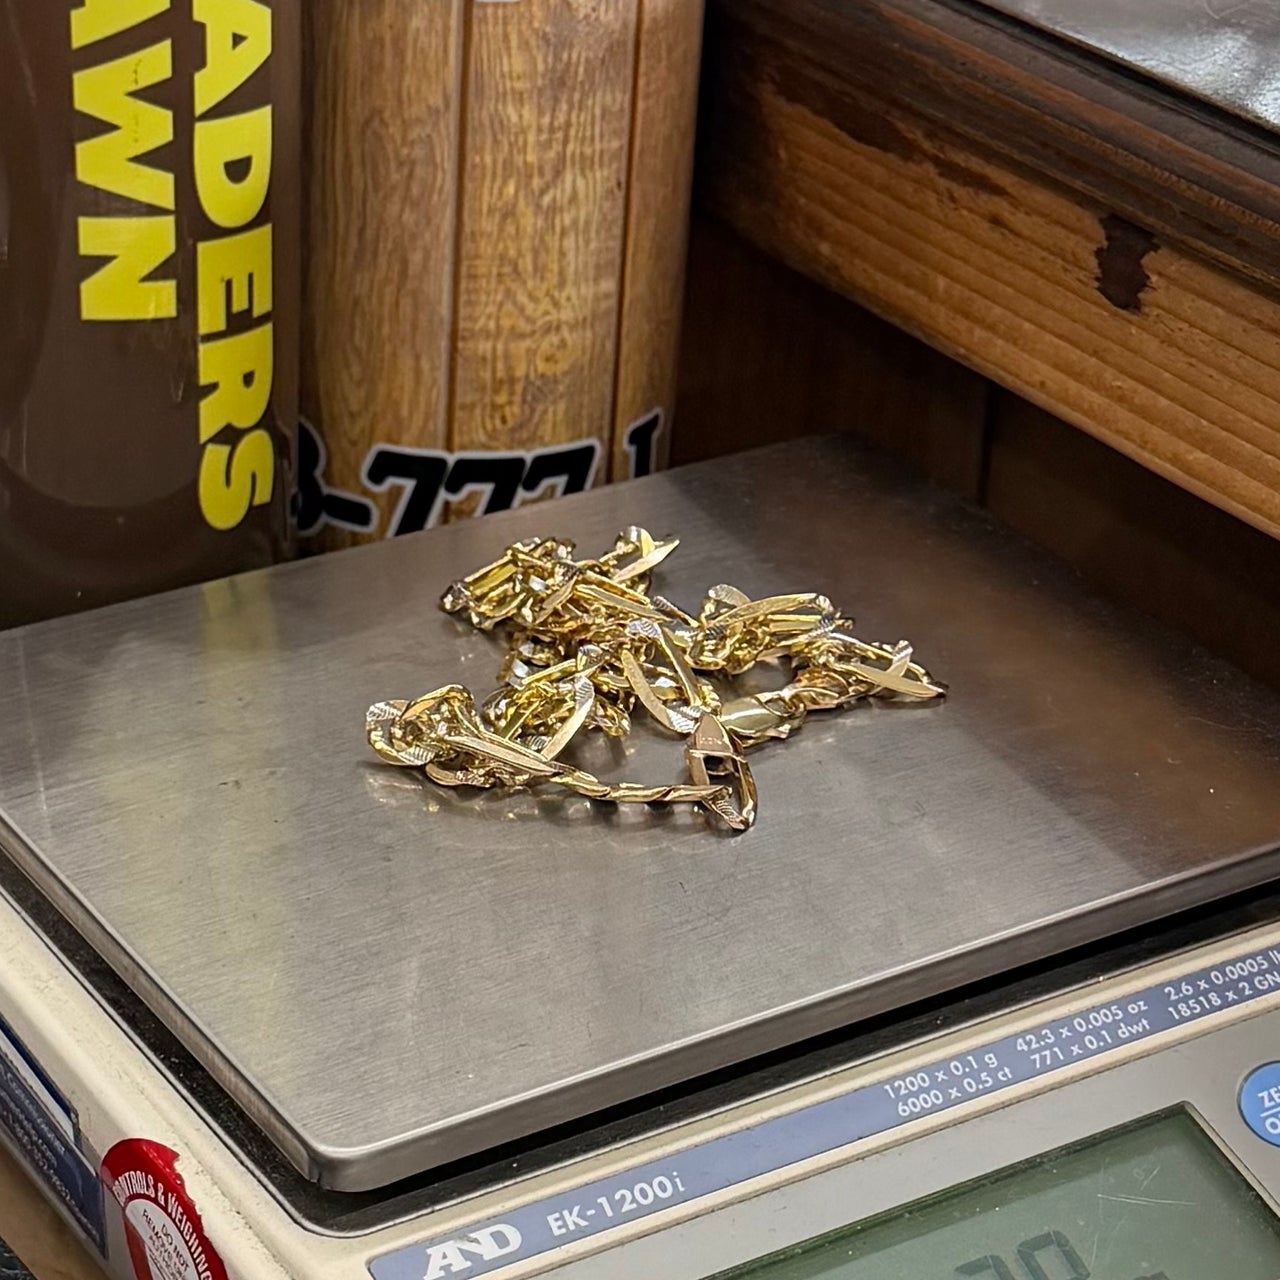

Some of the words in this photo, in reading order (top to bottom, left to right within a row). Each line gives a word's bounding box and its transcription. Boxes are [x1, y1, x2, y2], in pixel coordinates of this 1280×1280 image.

[883, 1072, 930, 1100] 1200
[935, 1070, 949, 1083] x
[951, 1055, 979, 1077] 0.1
[985, 1052, 999, 1069] g
[1016, 1029, 1056, 1053] 42.3
[1059, 1026, 1073, 1038] x
[1074, 1006, 1124, 1034] 0.005
[1127, 999, 1149, 1015] oz
[1164, 982, 1193, 1001] 2.6
[1197, 979, 1210, 991] x
[1210, 955, 1268, 985] 0.0005
[897, 1090, 943, 1117] 6000
[948, 1087, 962, 1100] x
[964, 1073, 993, 1094] 0.5
[998, 1066, 1012, 1083] ct
[1030, 1048, 1065, 1070] 771
[1071, 1044, 1083, 1056] x
[1084, 1031, 1112, 1050] 0.1
[1118, 1018, 1151, 1039] dwt
[1167, 995, 1222, 1021] 18518
[1225, 990, 1239, 1002] x
[1239, 981, 1253, 997] 2
[546, 1171, 687, 1238] EK-1200i
